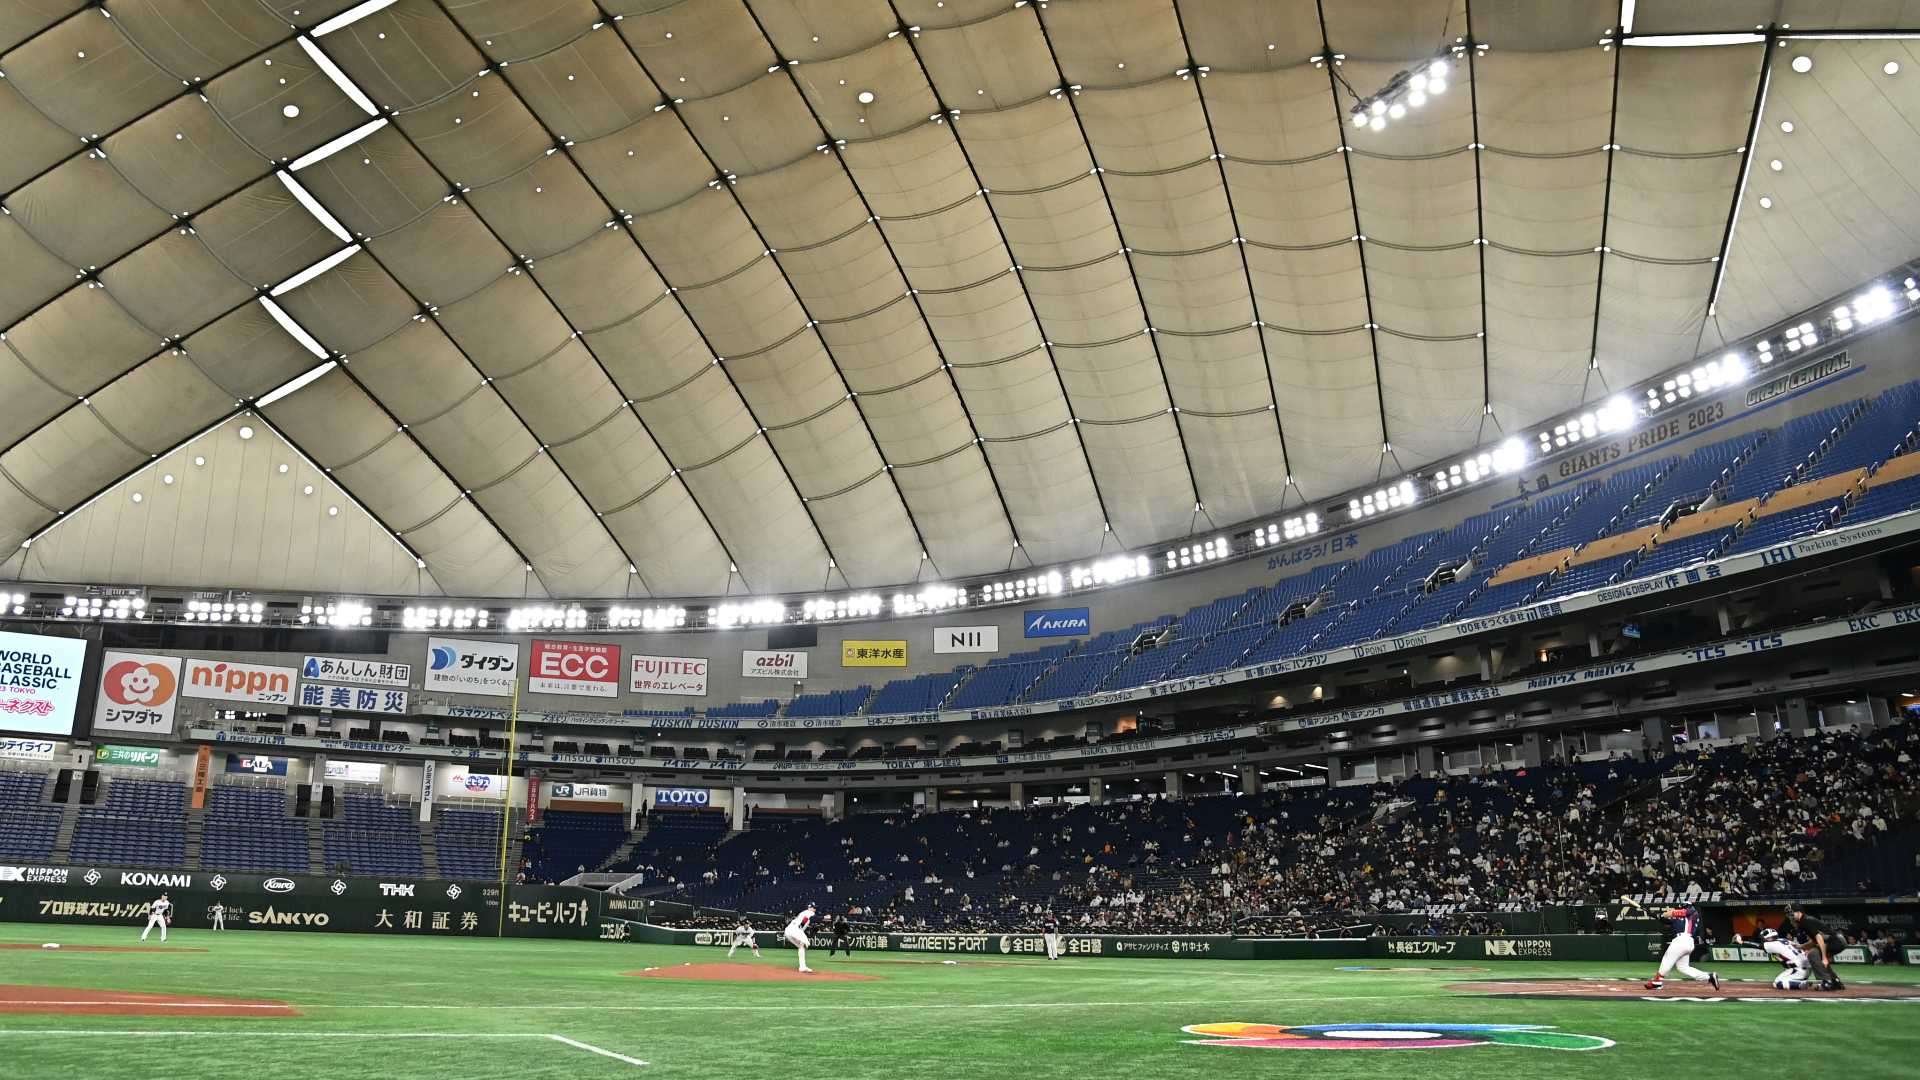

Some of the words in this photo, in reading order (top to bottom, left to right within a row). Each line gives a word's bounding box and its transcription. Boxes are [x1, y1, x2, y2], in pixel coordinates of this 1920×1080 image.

[1790, 351, 1850, 388] CENTRAL
[1559, 443, 1621, 477] GIANTS
[1627, 419, 1680, 452] PRIDE
[1688, 401, 1724, 430] 2023
[1760, 545, 1797, 566] IHI
[1798, 538, 1839, 553] Parking
[1839, 526, 1882, 544] Systems
[1043, 619, 1087, 629] AKIRA
[1848, 616, 1880, 632] EKC
[952, 632, 981, 647] NII
[756, 654, 794, 667] azbil
[856, 648, 905, 659] 東洋水産
[461, 653, 514, 672] ダイダン
[540, 652, 609, 679] ECC
[634, 660, 706, 678] FUJITEC
[0, 662, 72, 679] ASEBALL
[320, 660, 408, 681] あんしん財団
[0, 674, 57, 689] LASSIC
[191, 663, 289, 695] nippn
[635, 680, 703, 691] 世界のエレベータ
[258, 693, 287, 702] ニップン
[303, 685, 403, 713] 能美防災
[105, 708, 163, 725] シマダヤ
[651, 719, 693, 728] DUSKIN
[698, 719, 739, 728] DUSKIN
[658, 790, 708, 804] TOTO
[26, 875, 67, 884] EXPRESS
[28, 867, 69, 877] NIPPON
[120, 872, 191, 888] KONAMI
[265, 878, 294, 891] Kowa
[380, 883, 415, 897] THK
[508, 901, 578, 924] キューピーハーフ
[609, 900, 627, 910] MIWA
[248, 905, 329, 926] SANKYO
[374, 909, 479, 930] 大和証券
[918, 937, 956, 950] MEETS
[958, 937, 988, 951] PORT
[1013, 938, 1045, 952] 全日警
[1068, 938, 1102, 953] 全日警
[1396, 941, 1456, 954] 長谷工グループ
[1517, 940, 1551, 948] NIPPON
[1517, 948, 1552, 956] EXPRESS
